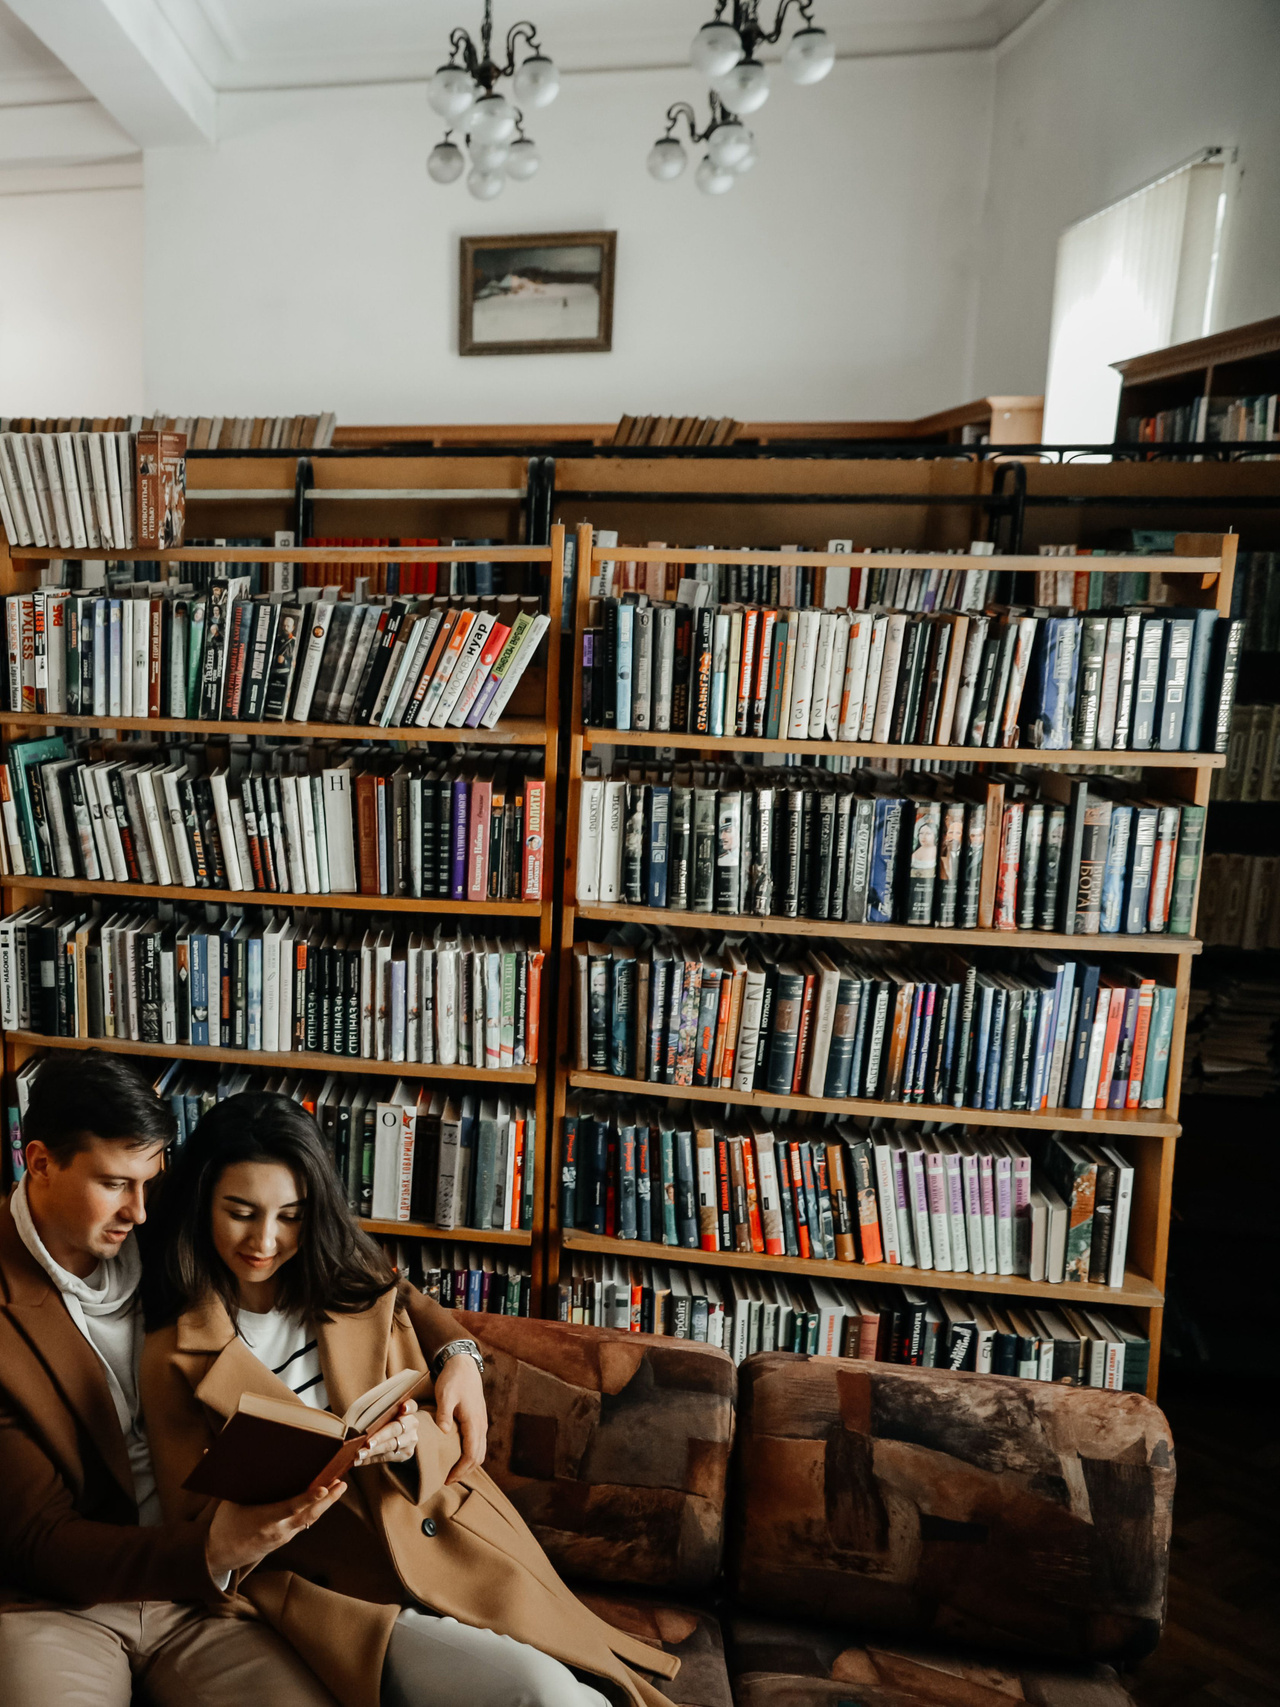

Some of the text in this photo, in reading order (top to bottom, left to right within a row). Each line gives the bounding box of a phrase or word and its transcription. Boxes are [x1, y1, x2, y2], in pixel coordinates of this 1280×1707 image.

[331, 776, 343, 791] Н
[530, 789, 540, 831] ЛОЛИТА
[762, 988, 772, 1028] КОТЛОВАН
